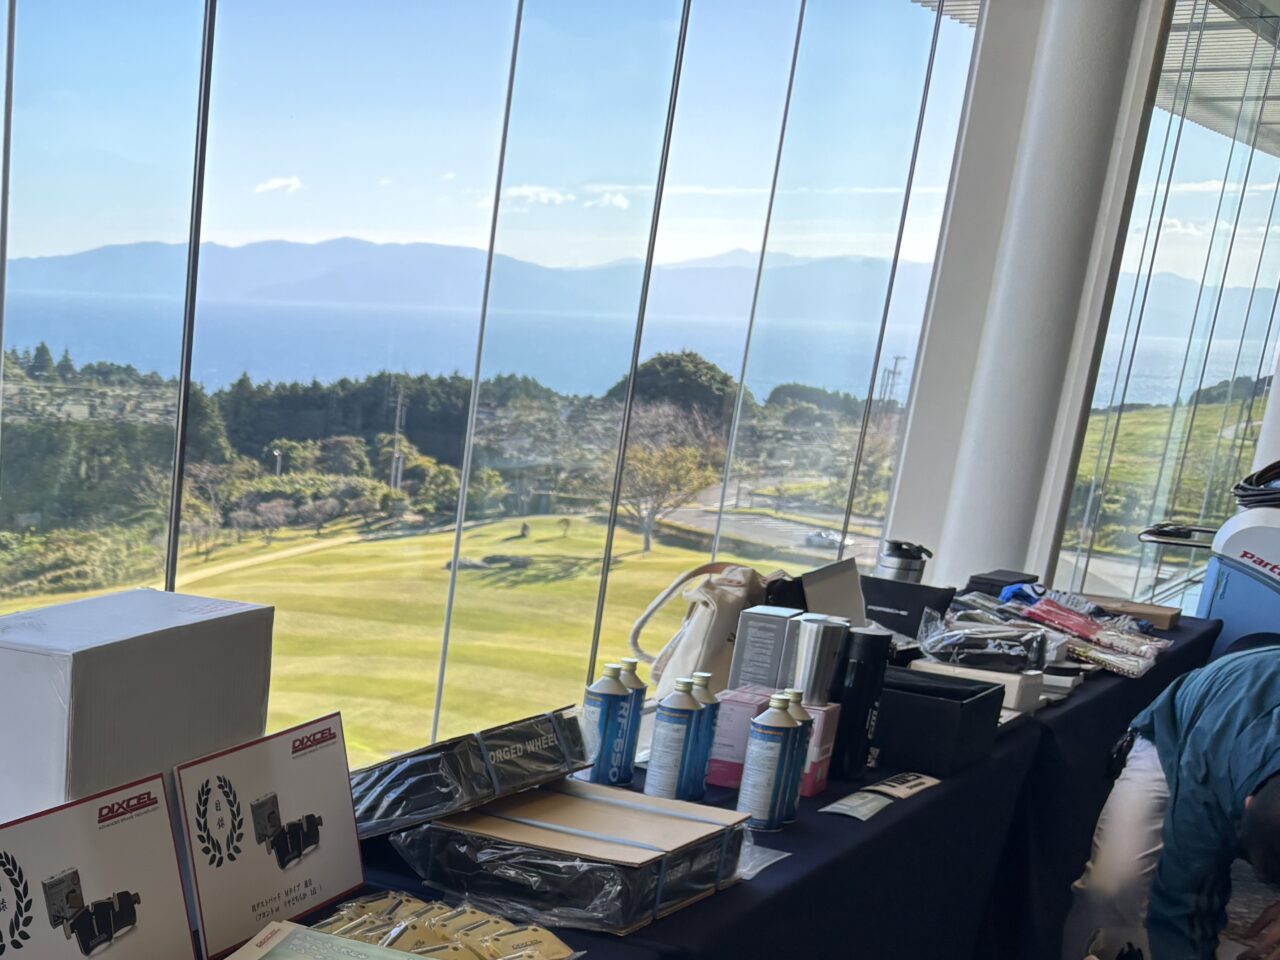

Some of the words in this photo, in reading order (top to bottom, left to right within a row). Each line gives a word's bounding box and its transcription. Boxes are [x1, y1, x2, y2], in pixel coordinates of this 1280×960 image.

[292, 727, 337, 754] DIXCEL
[488, 743, 523, 764] ORGED
[609, 701, 630, 782] RF-650
[98, 791, 158, 822] DIXCEL
